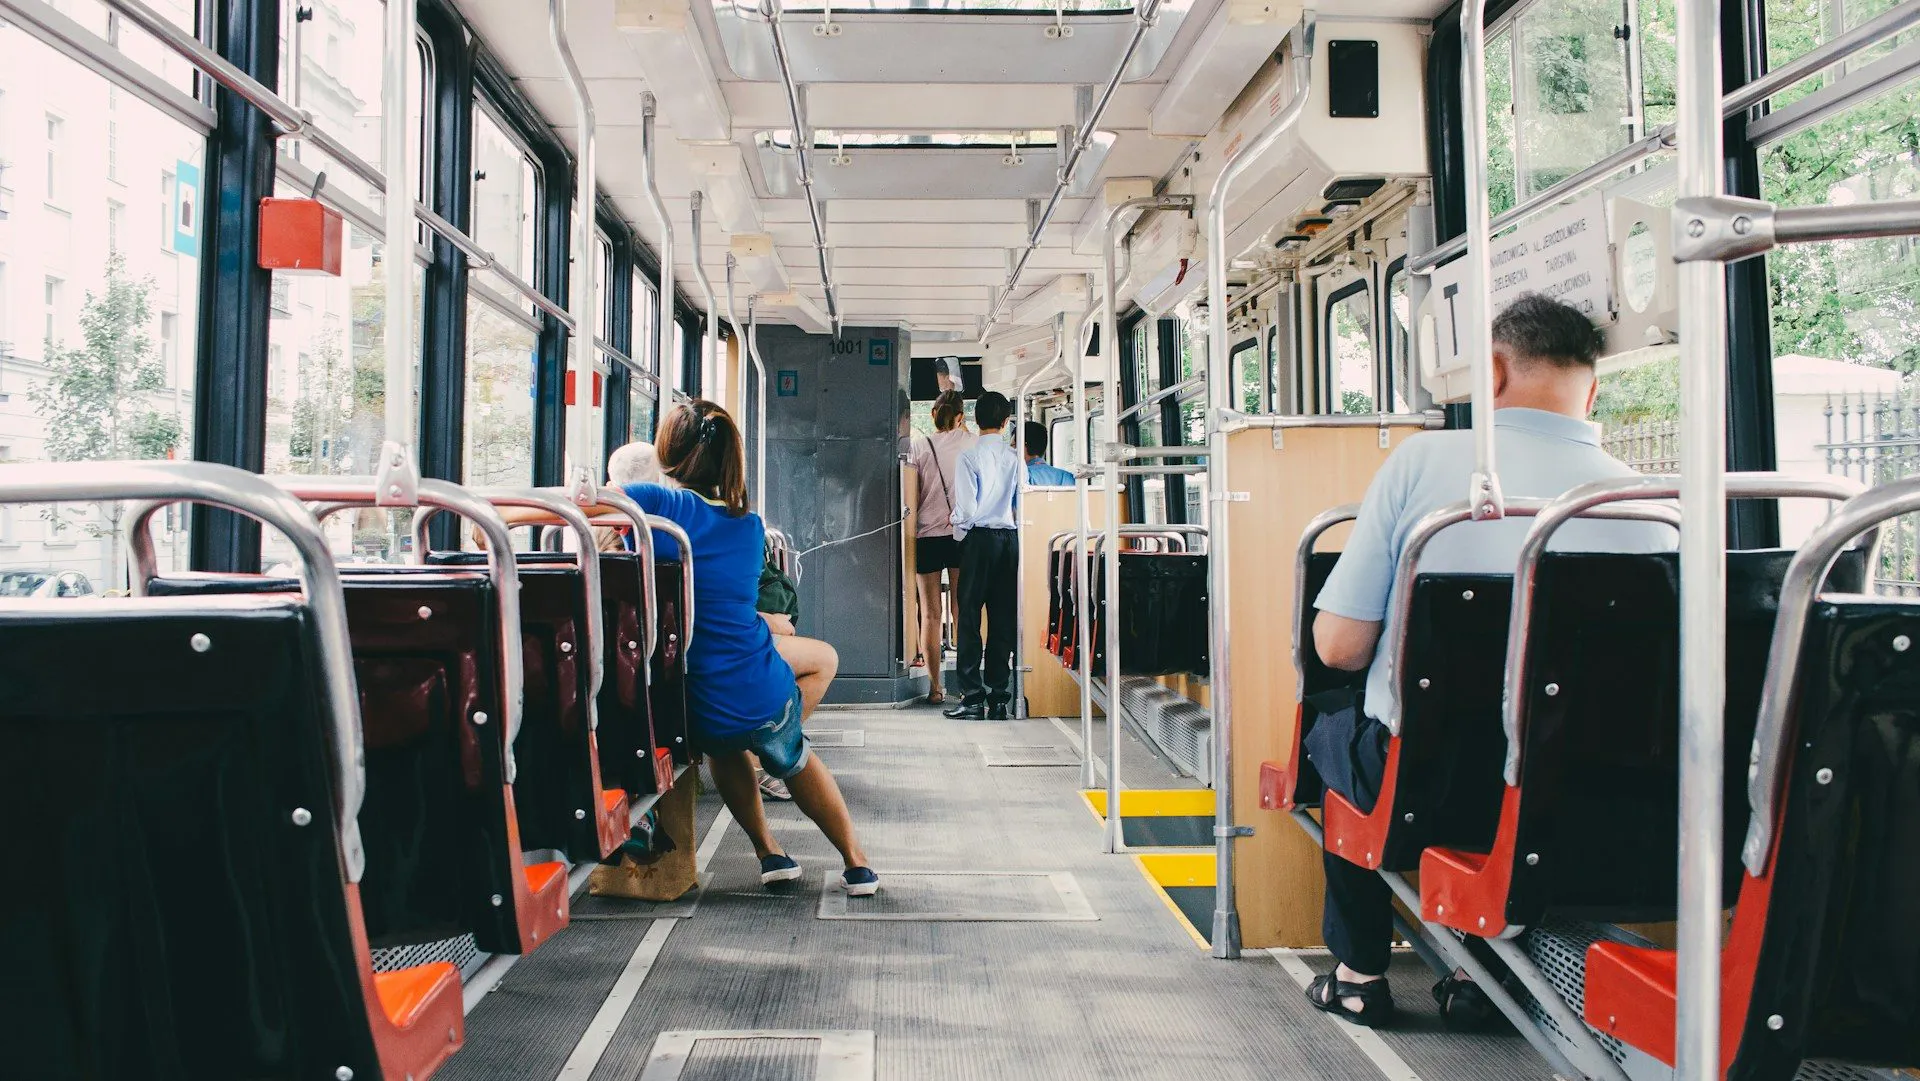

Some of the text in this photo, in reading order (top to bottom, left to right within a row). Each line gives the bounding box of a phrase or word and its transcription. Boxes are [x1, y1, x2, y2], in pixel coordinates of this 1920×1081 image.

[1545, 249, 1577, 274] TARGOWA
[1443, 282, 1459, 356] T
[829, 340, 862, 354] 1001
